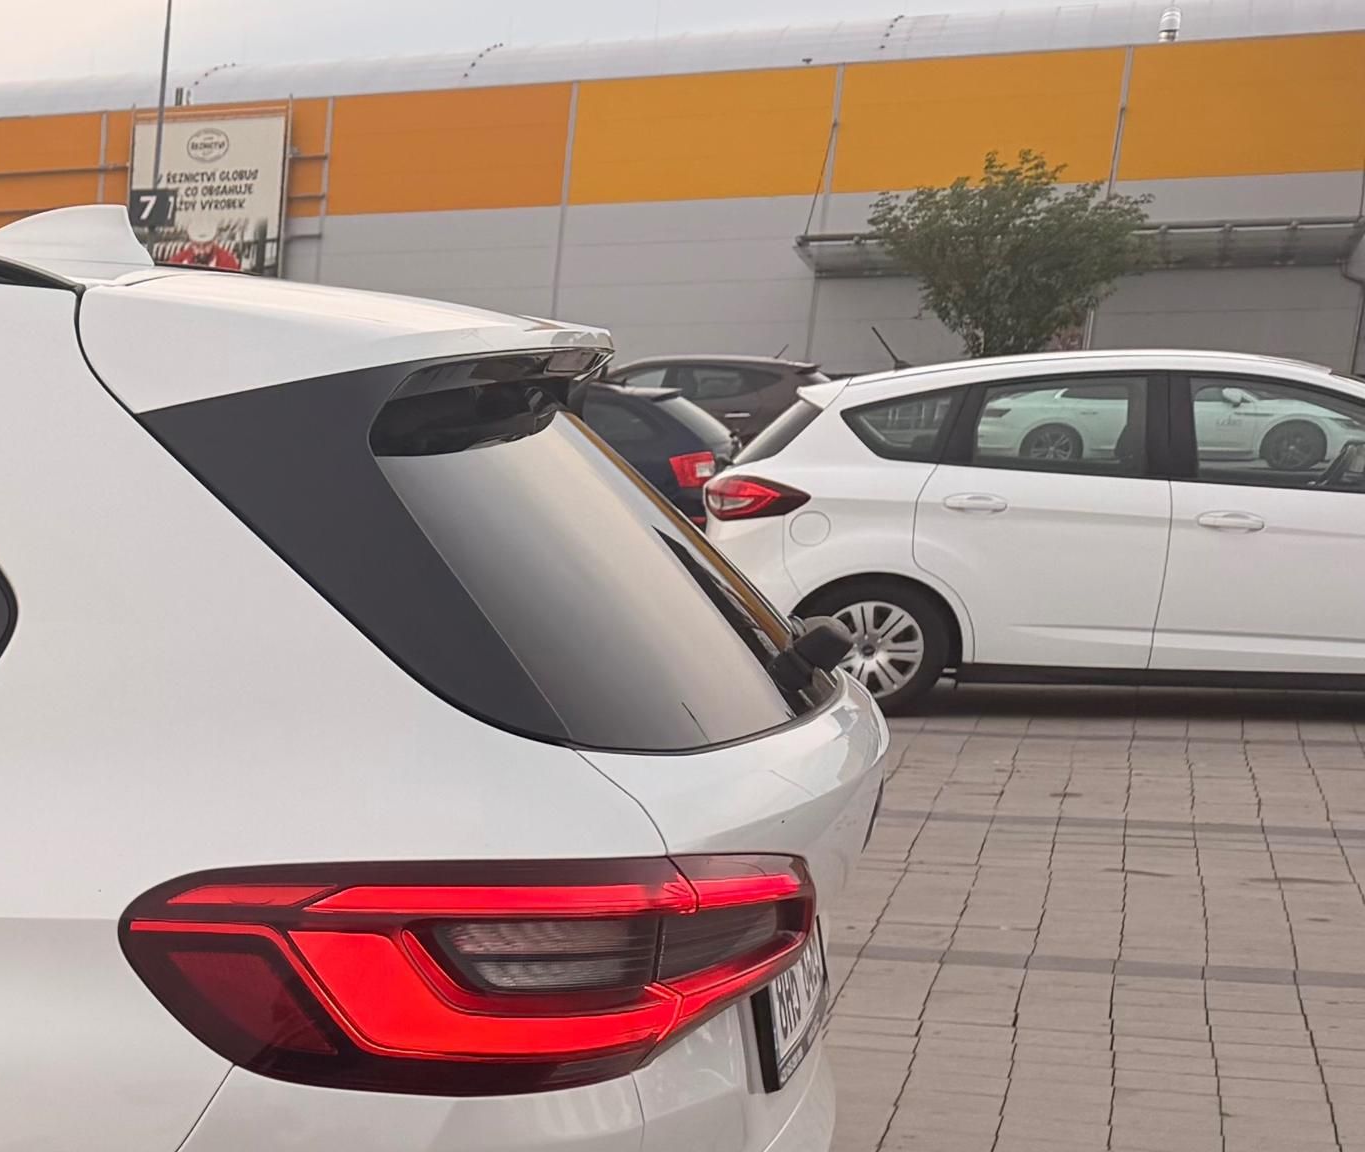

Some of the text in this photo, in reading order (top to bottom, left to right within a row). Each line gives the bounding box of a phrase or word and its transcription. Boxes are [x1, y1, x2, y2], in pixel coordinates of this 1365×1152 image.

[219, 168, 259, 181] GLOBUS
[184, 183, 254, 197] CO OBSAHUJE
[139, 195, 157, 220] 7
